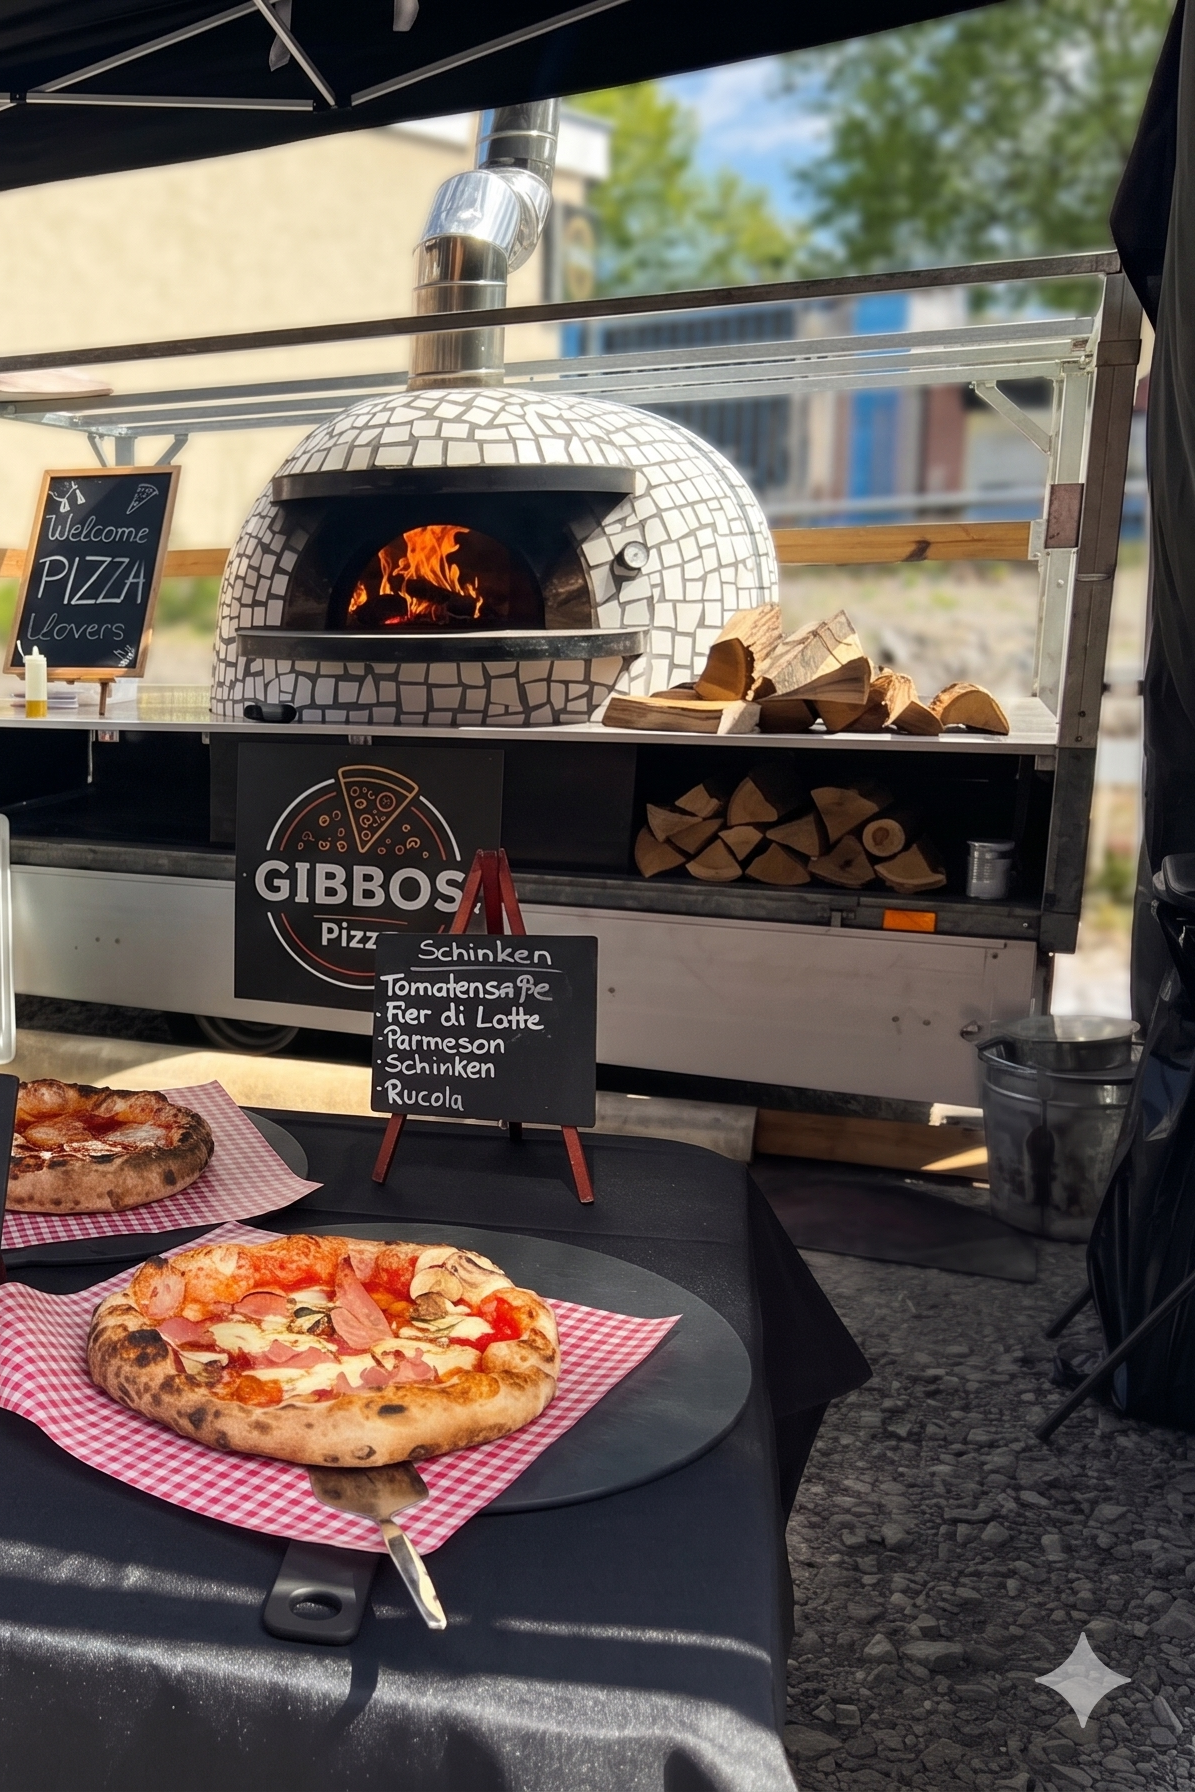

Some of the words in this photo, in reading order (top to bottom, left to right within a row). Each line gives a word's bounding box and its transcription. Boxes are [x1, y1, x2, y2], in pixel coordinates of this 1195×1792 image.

[45, 513, 149, 543] Welcome
[38, 555, 146, 605] PIZZA
[255, 860, 467, 913] GIBBOS
[321, 921, 399, 949] Pizz
[418, 939, 552, 965] Schinken
[440, 1002, 465, 1027] di
[384, 1053, 496, 1079] Schinken
[384, 1078, 465, 1112] Rucola
